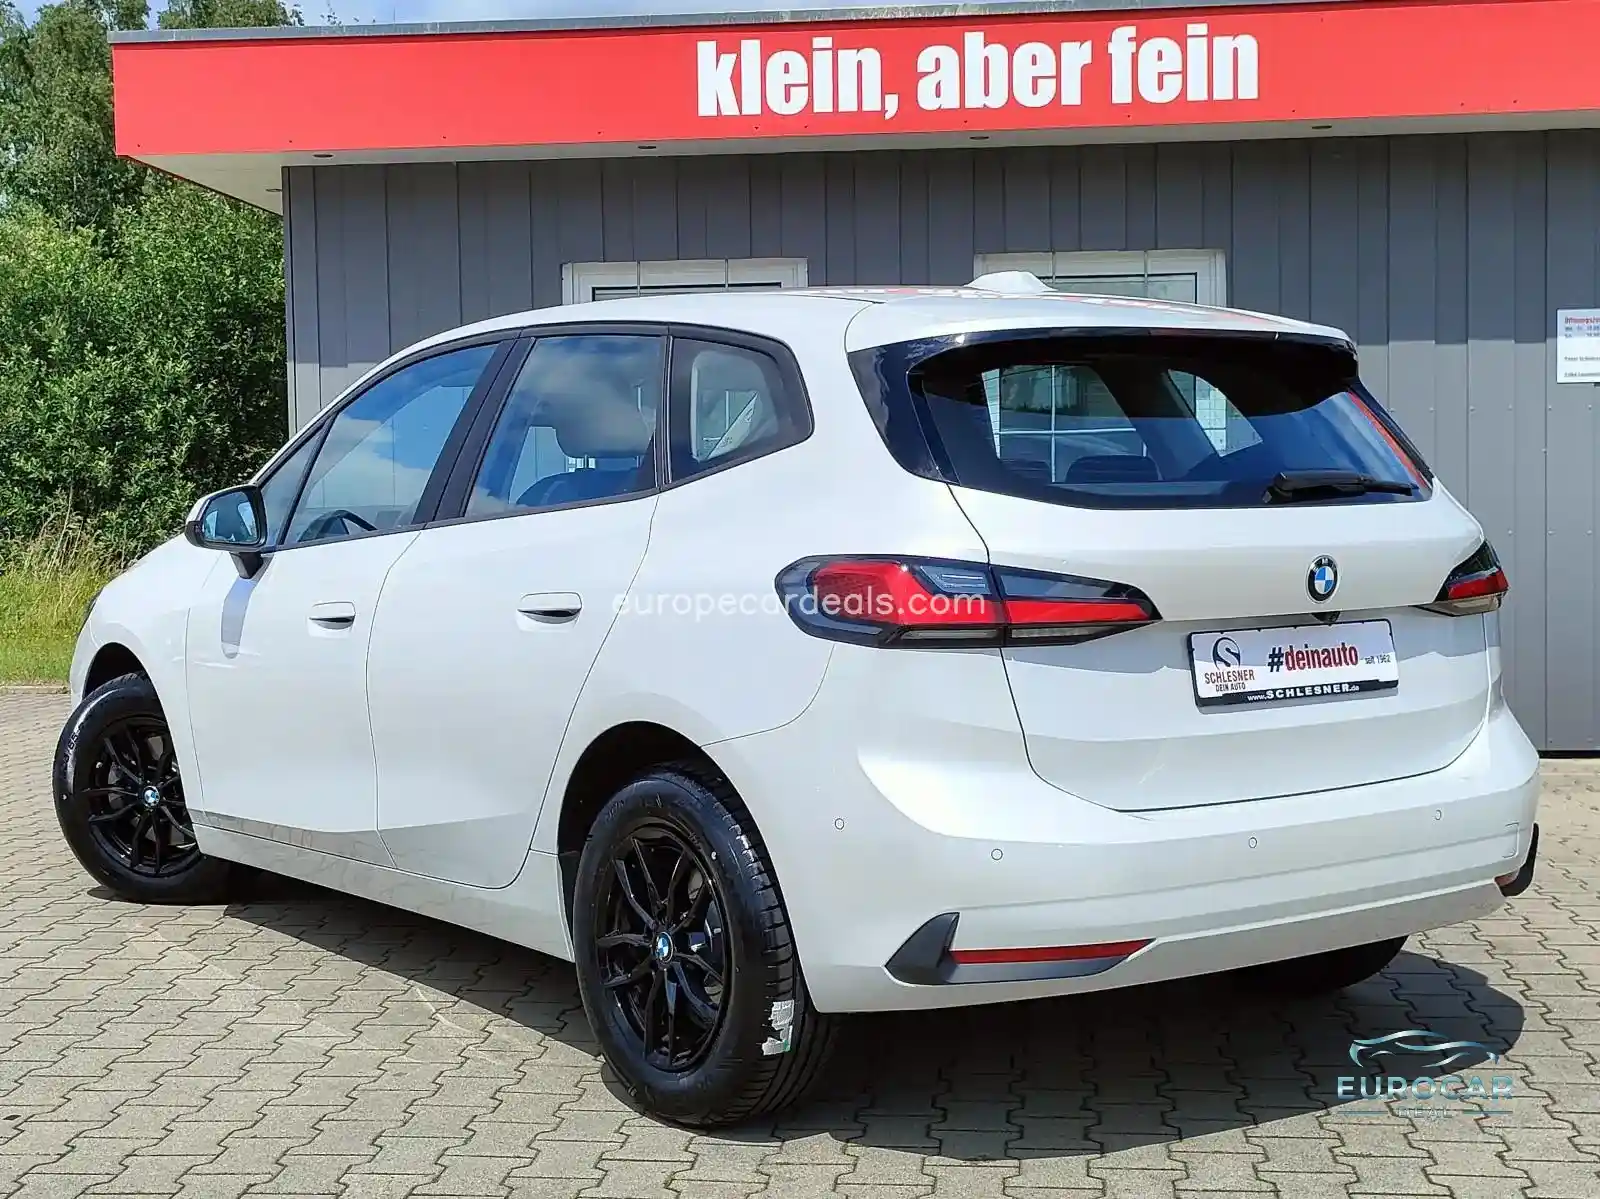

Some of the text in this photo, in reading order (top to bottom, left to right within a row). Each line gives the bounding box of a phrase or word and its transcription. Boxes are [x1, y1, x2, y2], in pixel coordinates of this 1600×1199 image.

[696, 23, 1259, 121] klein, aber fein
[1267, 642, 1359, 673] #deinauto
[1204, 669, 1255, 685] SCHLESNER
[1215, 682, 1246, 692] DEIN AUTO
[1247, 683, 1360, 701] www.SCHLESNER.de
